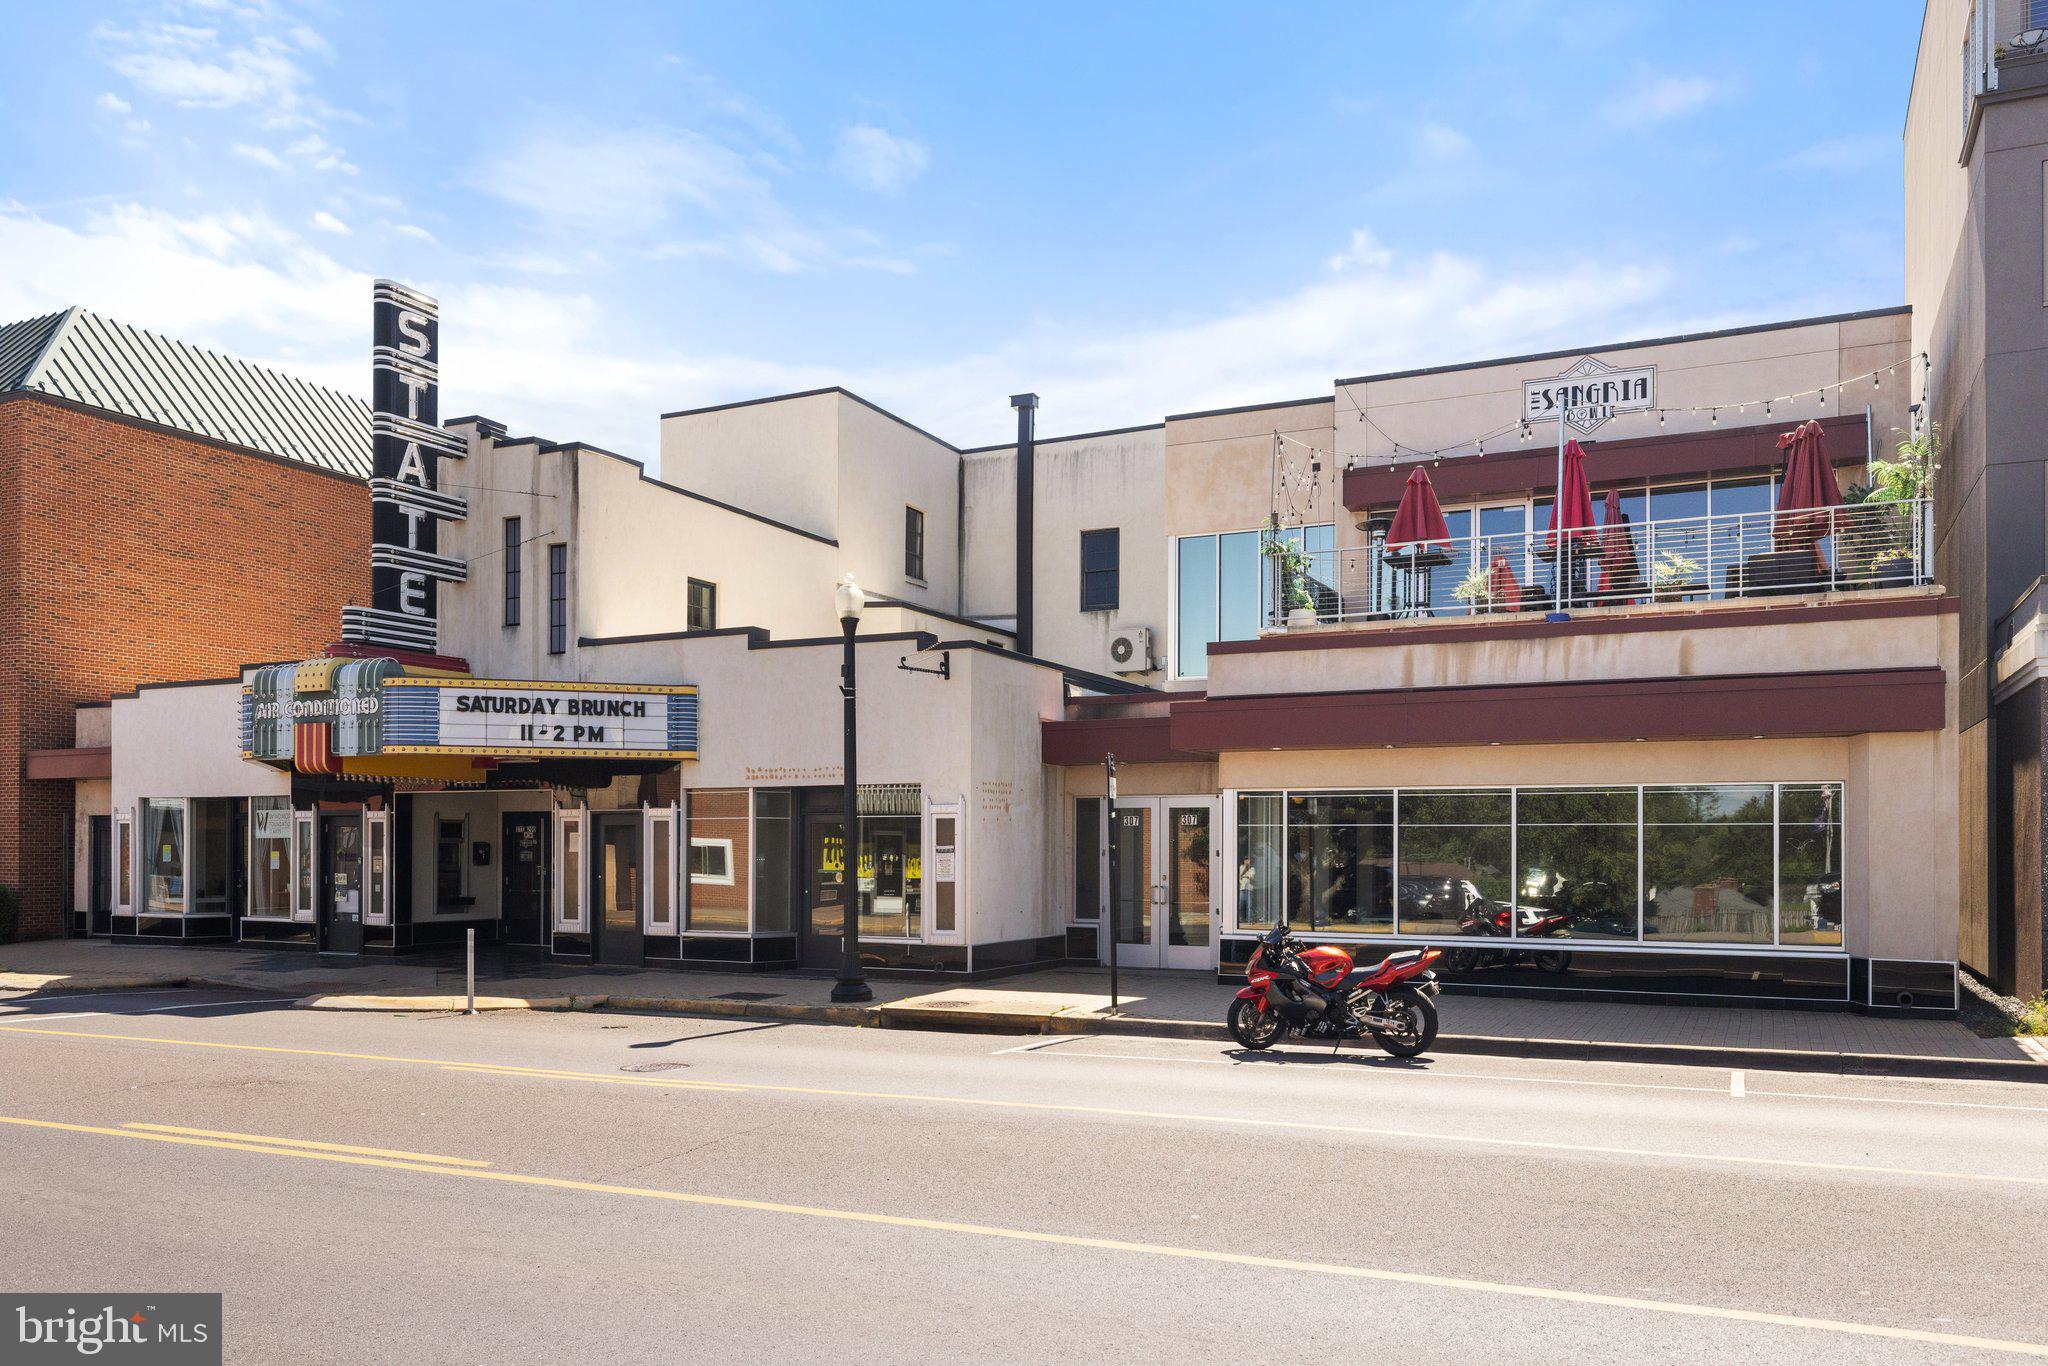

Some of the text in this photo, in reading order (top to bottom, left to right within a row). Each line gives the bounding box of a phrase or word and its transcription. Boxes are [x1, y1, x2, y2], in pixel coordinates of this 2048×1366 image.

[1530, 390, 1540, 411] THE
[1541, 377, 1648, 411] SANGRIA
[398, 310, 431, 616] STATE
[255, 696, 379, 719] AIR CONDITIONED
[456, 695, 646, 717] SATURDAY BRUNCH
[573, 725, 604, 743] PM
[1124, 816, 1139, 826] 307
[1182, 815, 1197, 825] 307
